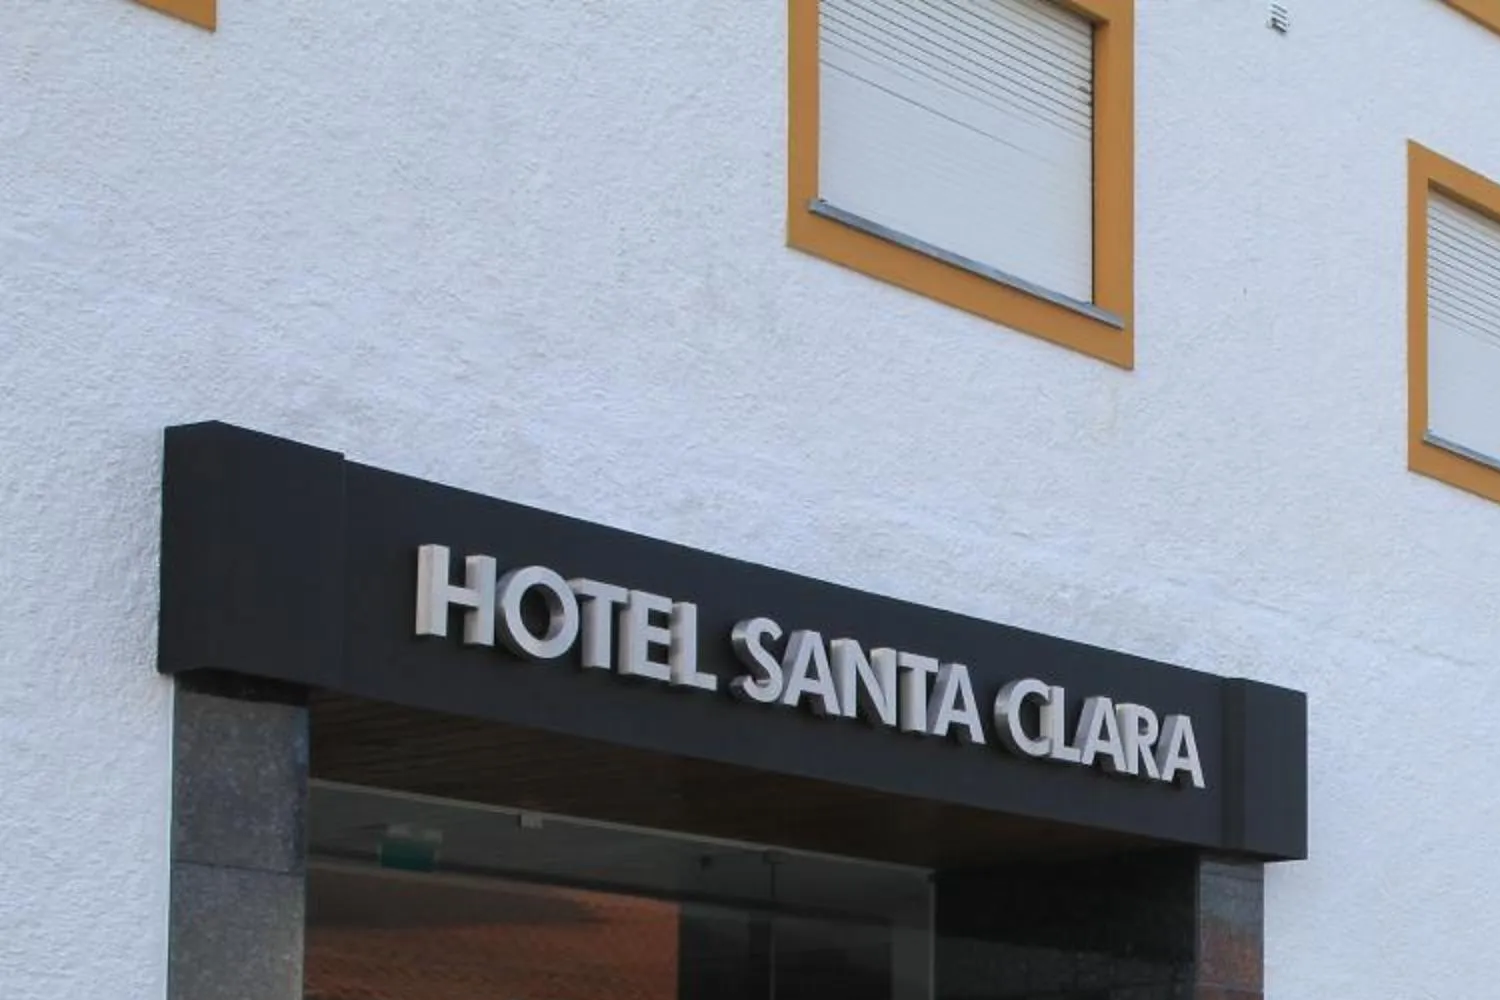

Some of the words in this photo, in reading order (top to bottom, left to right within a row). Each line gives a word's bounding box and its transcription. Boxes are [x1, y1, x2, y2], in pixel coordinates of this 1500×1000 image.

[415, 543, 718, 692] HOTEL
[730, 616, 986, 745] SANTA
[994, 677, 1206, 789] CLARA
